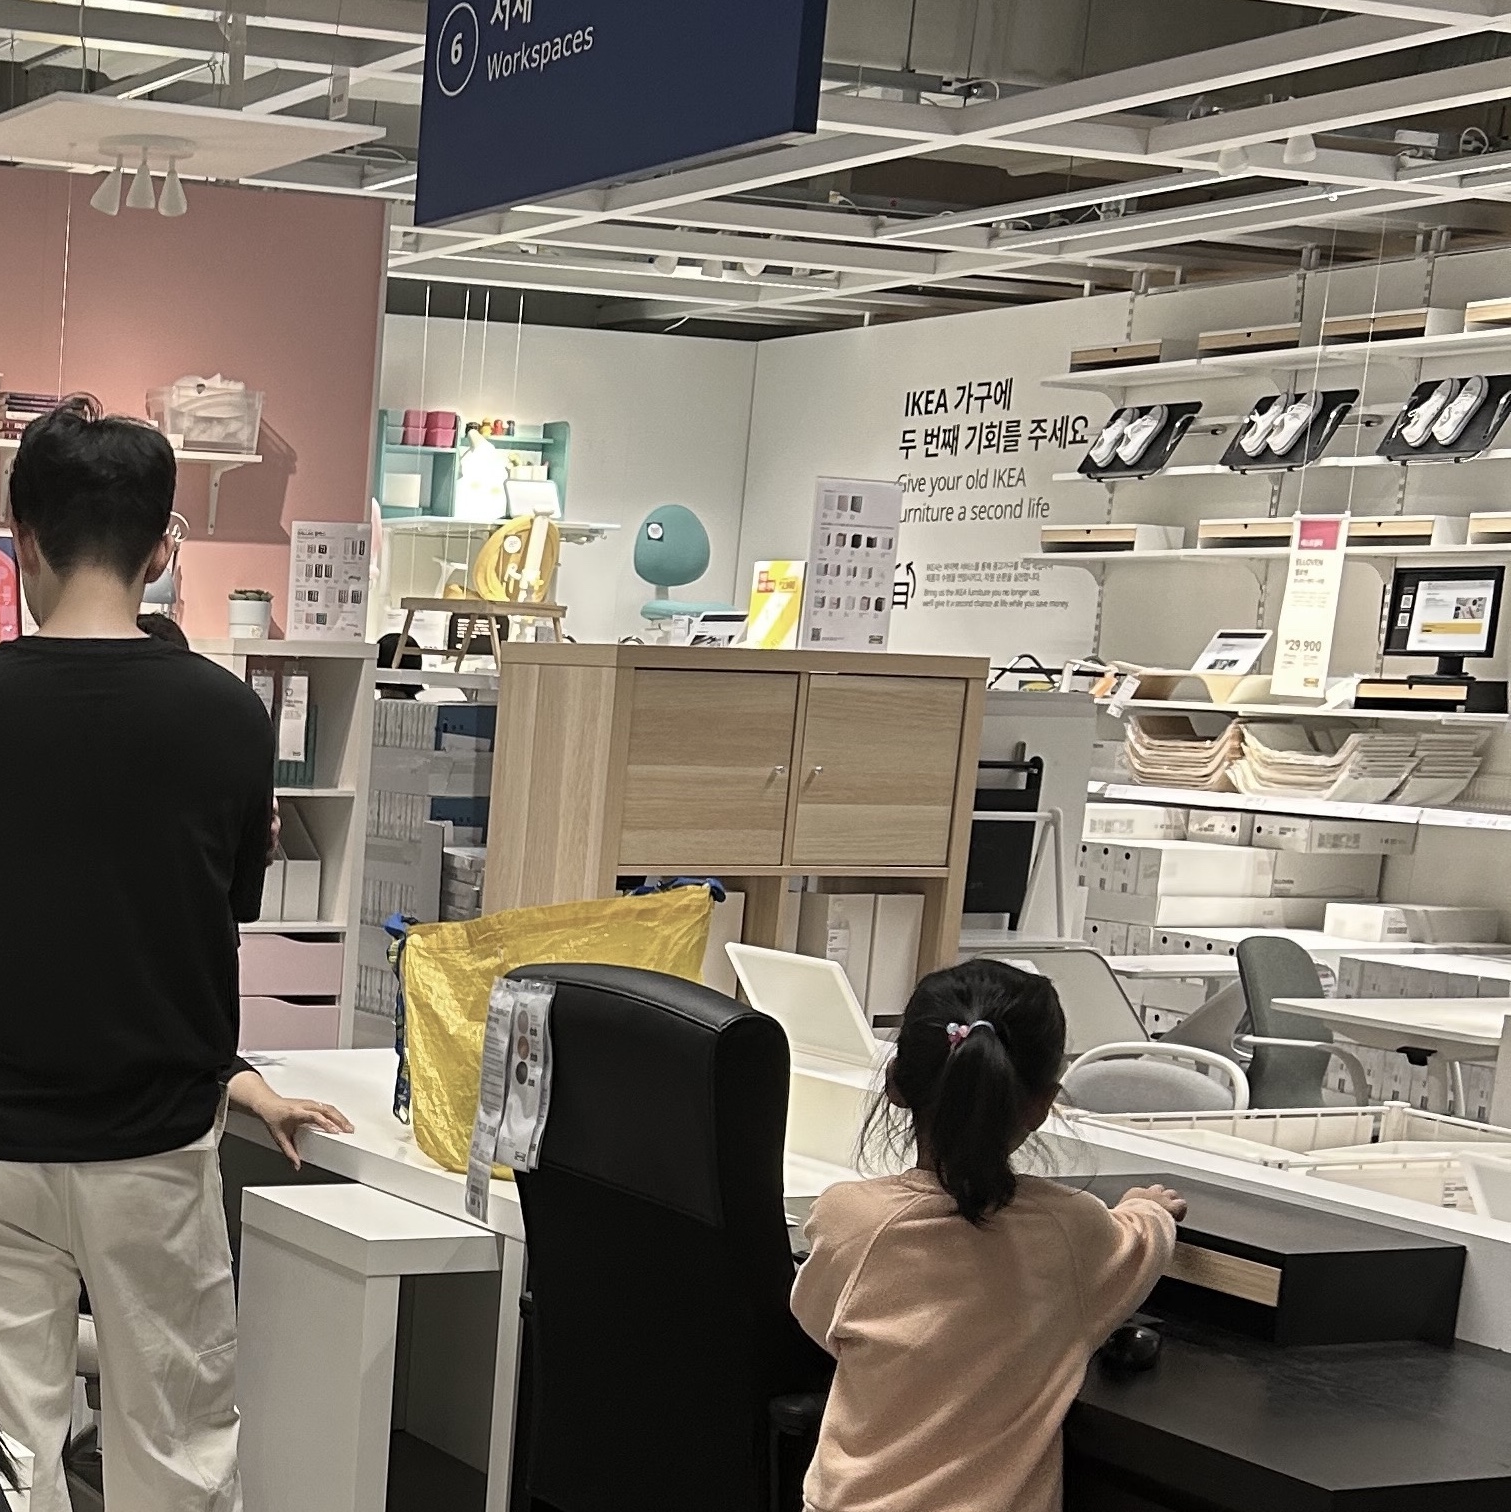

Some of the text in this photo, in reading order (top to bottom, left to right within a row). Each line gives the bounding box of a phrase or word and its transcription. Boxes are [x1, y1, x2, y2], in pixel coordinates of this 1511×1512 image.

[450, 32, 463, 65] 6
[488, 26, 594, 82] Workspaces
[904, 378, 1013, 417] IKEA 가구에
[899, 415, 1089, 459] 두 번째 기회를 주세요
[928, 475, 963, 498] your
[966, 470, 989, 490] old
[992, 467, 1026, 489] IKEA
[899, 497, 1050, 524] urniture a second life
